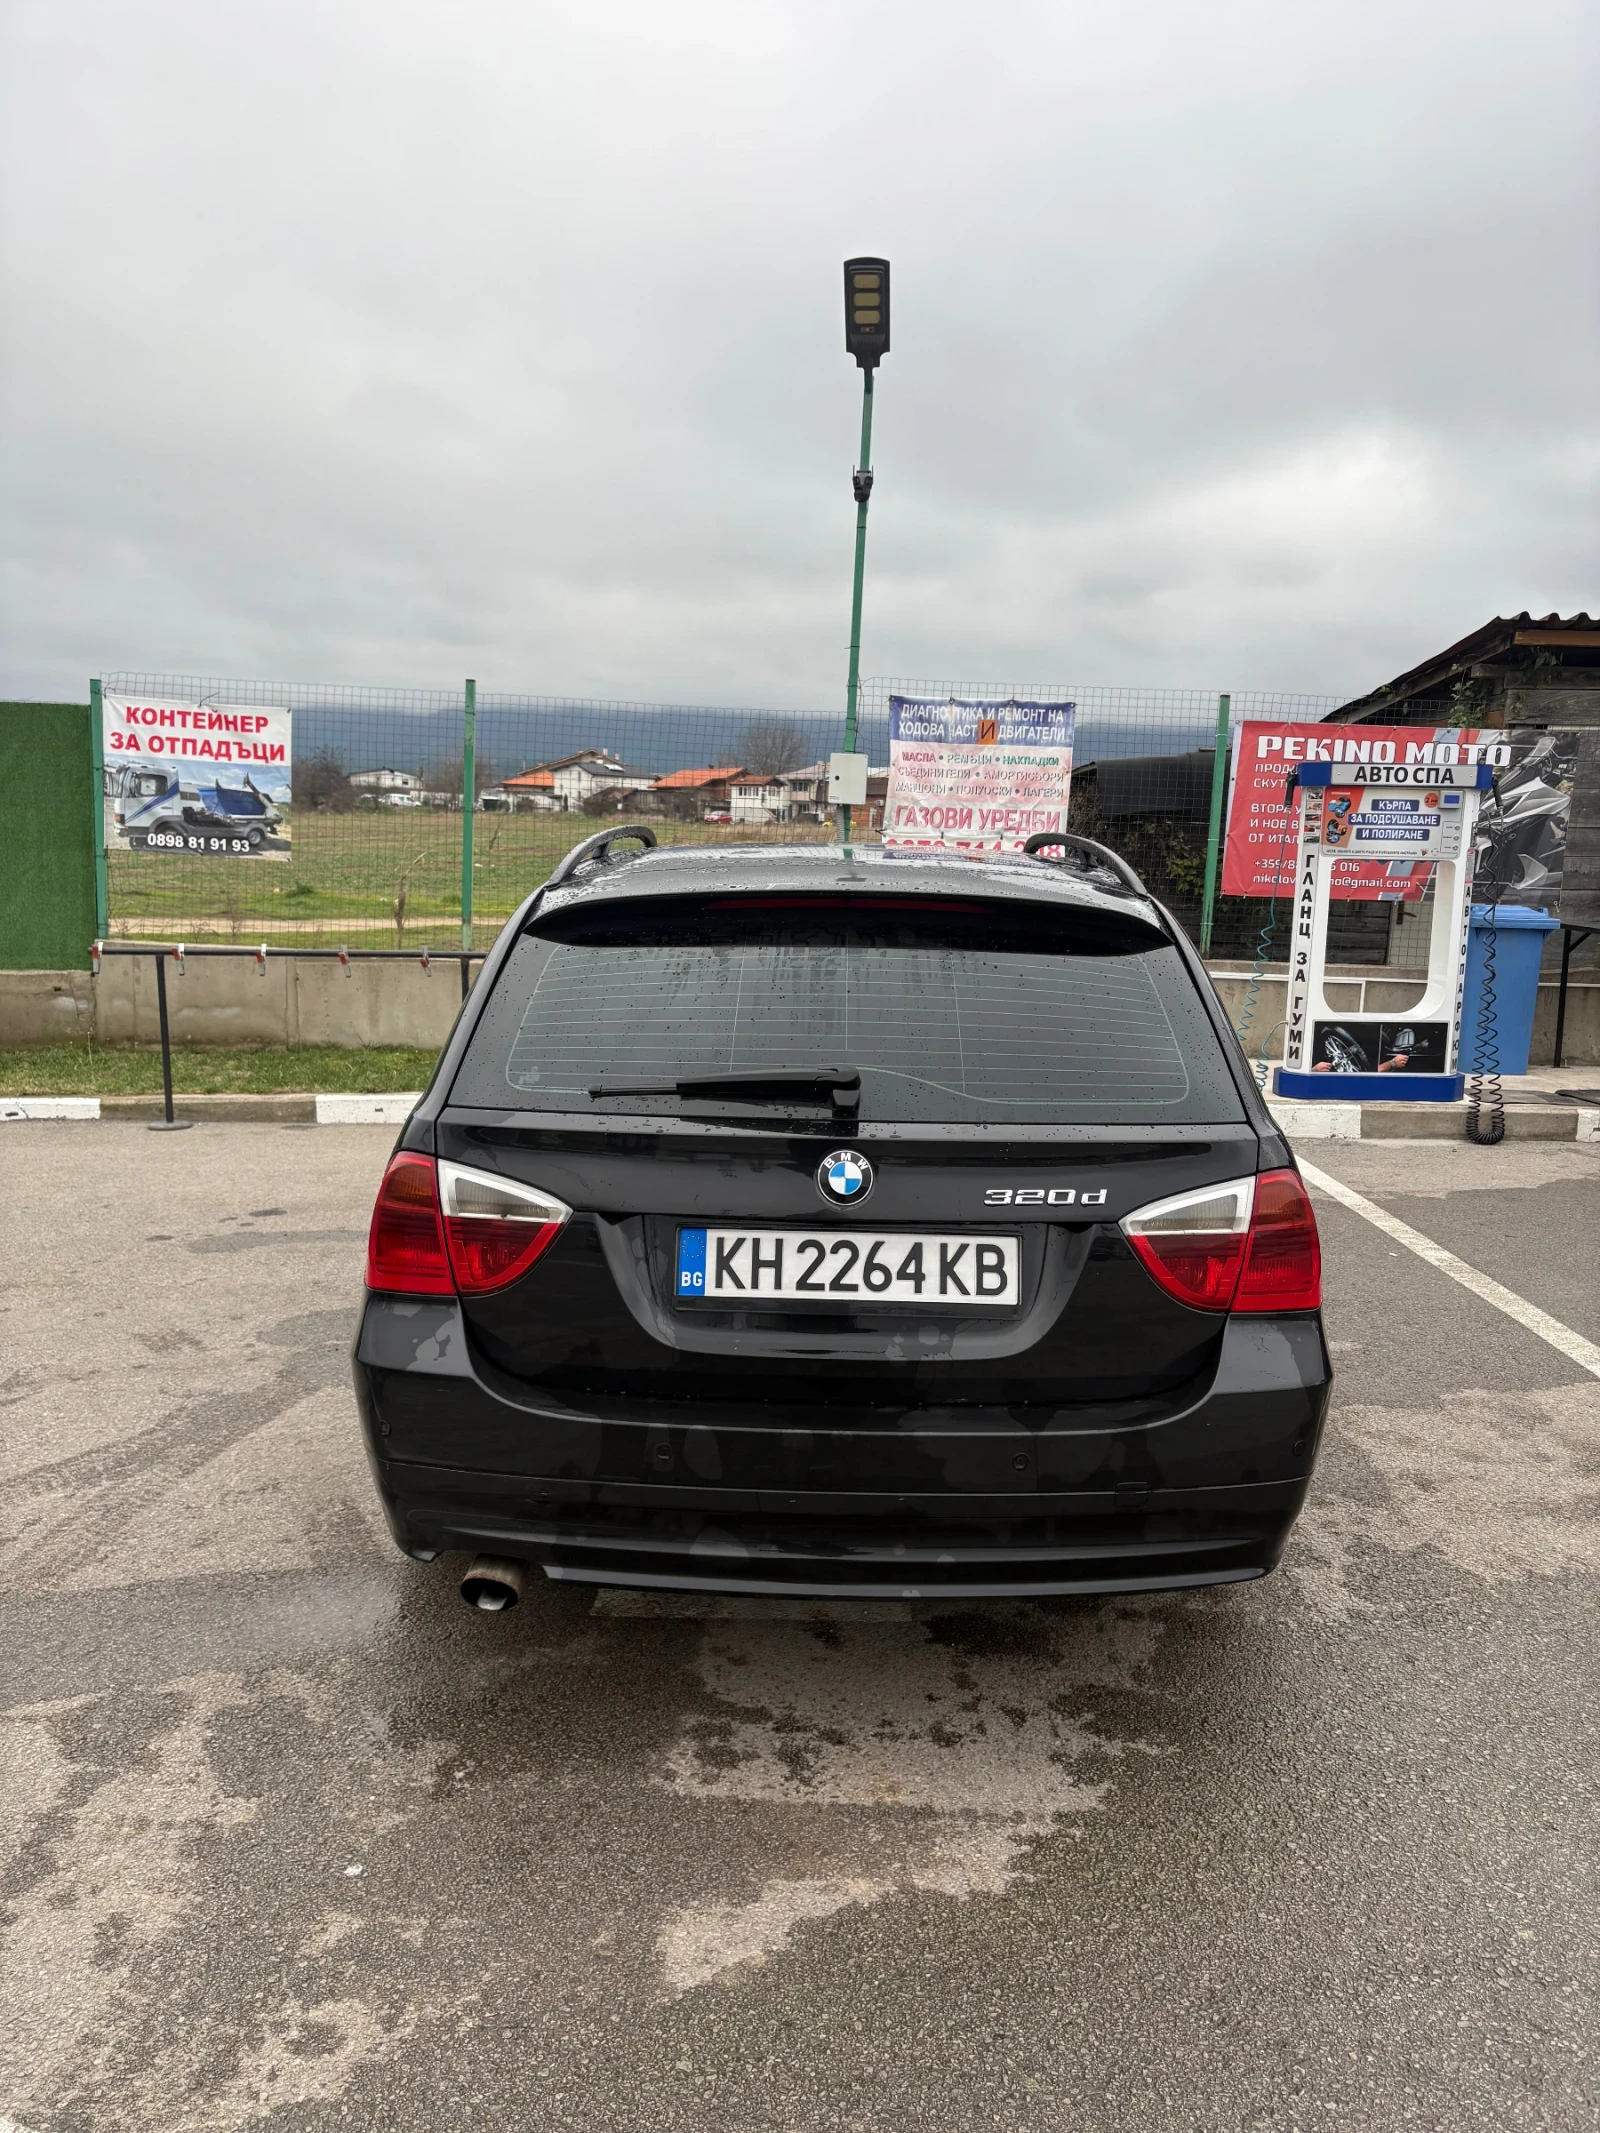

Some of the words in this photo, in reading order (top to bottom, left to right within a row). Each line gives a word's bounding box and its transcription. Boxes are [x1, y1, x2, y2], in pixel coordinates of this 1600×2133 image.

[125, 706, 269, 733] КОНТЕЙНЕР
[901, 703, 983, 721] ДИАГНОТИКА
[987, 707, 995, 719] И
[998, 707, 1045, 721] РЕМОНТ
[1048, 709, 1064, 723] НА
[898, 721, 944, 737] ХОДОВА
[981, 721, 995, 739] И
[998, 725, 1066, 741] ДВИГАТЕЛИ
[110, 732, 141, 751] ЗА
[148, 735, 285, 764] ОТПАДЪЦИ
[1256, 735, 1396, 764] PEKINO
[902, 751, 937, 763] МАСЛА
[947, 754, 992, 766] РЕМЪЦИ
[1002, 755, 1059, 767] НАКЛАДКИ
[898, 766, 971, 779] СЪЕДИНИТЕЛИ
[1354, 766, 1408, 783] АВТО
[1412, 767, 1454, 784] СПА
[956, 785, 1012, 797] ПОЛУОСКИ
[1022, 787, 1064, 798] ЛАГЕРИ
[1378, 801, 1412, 811] КЪРПА
[894, 804, 973, 830] ГАЗОВИ
[978, 808, 1060, 835] УРЕДБИ
[1250, 818, 1259, 828] И
[1350, 814, 1363, 823] ЗА
[1365, 814, 1438, 825] ПОДСУШАВАНЕ
[147, 833, 184, 848] 0898
[188, 836, 205, 849] 81
[210, 837, 227, 851] 91
[232, 839, 250, 853] 93
[1248, 833, 1265, 843] ОТ
[1268, 834, 1299, 844] ИТАЛ
[1362, 829, 1369, 838] И
[1372, 829, 1423, 840] ПОЛИРАНЕ
[1340, 862, 1360, 872] 016
[1299, 854, 1315, 939] ГЛАНЦ
[1295, 952, 1307, 983] ЗА
[1288, 997, 1303, 1060] ГУМИ
[824, 1152, 869, 1171] BMW
[984, 1189, 1107, 1206] 320d
[681, 1271, 703, 1287] BG
